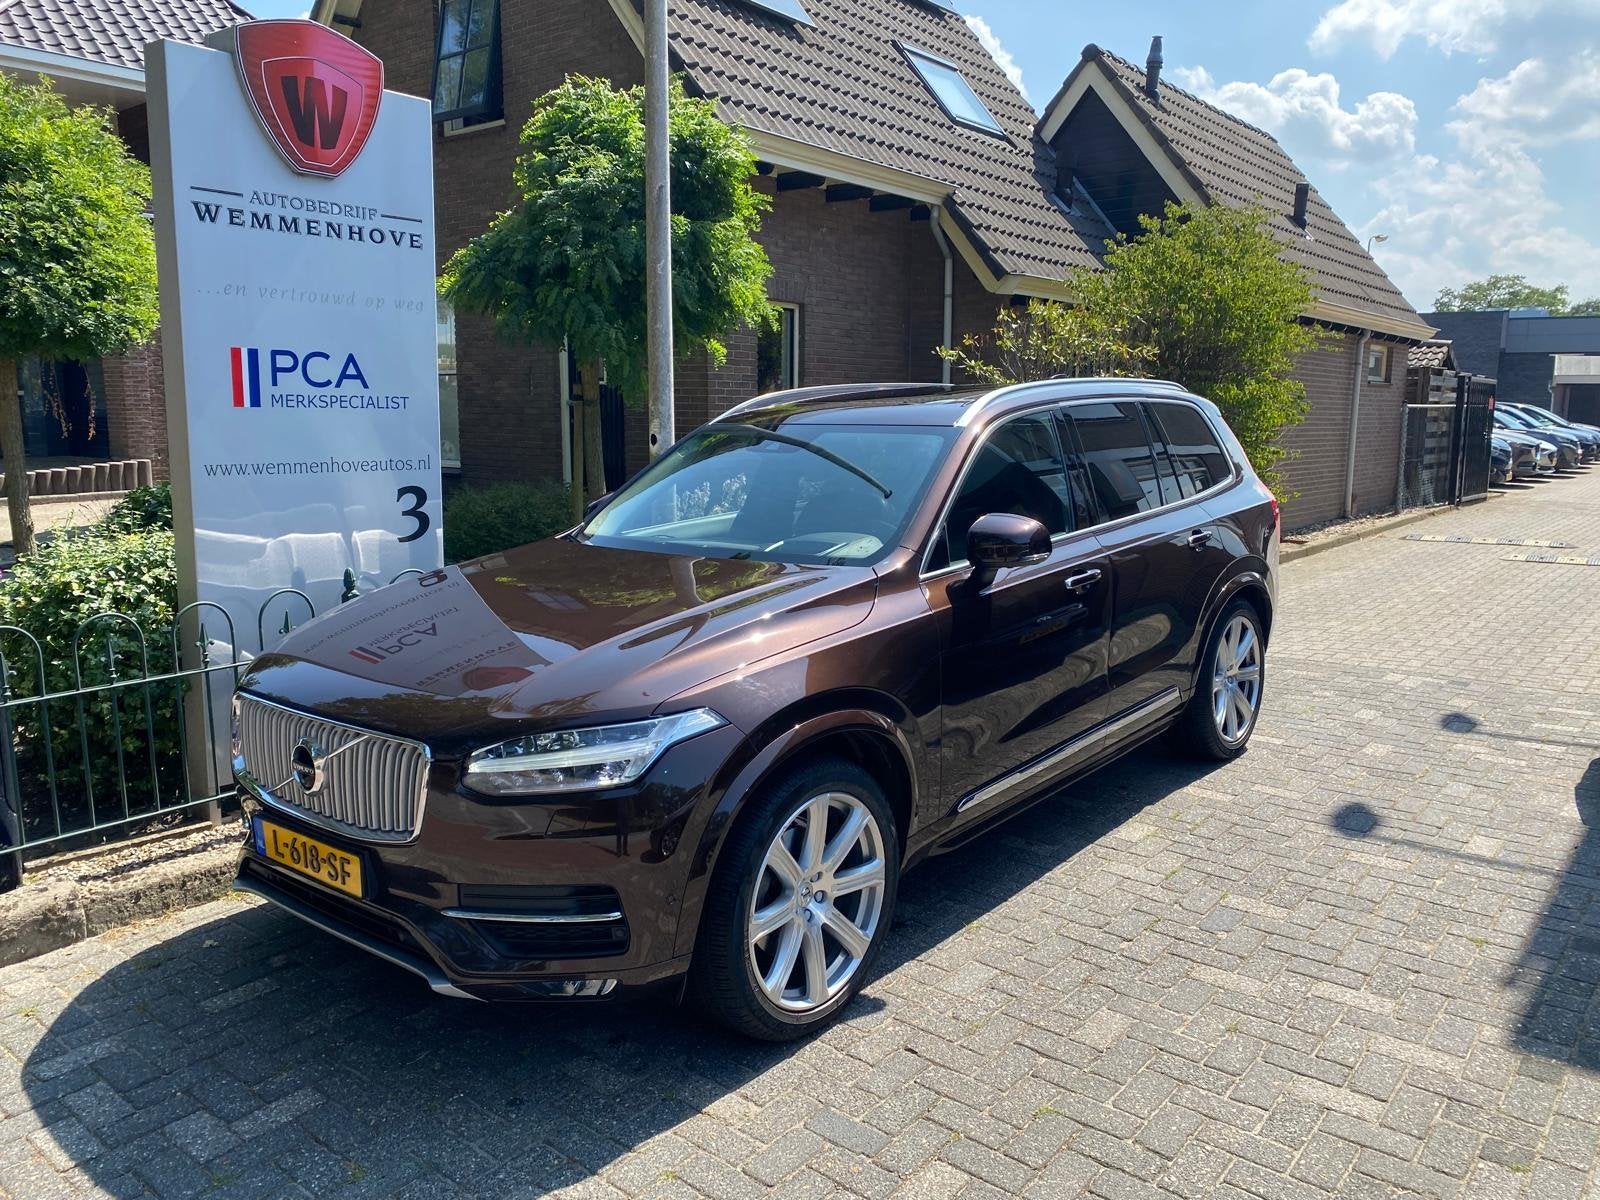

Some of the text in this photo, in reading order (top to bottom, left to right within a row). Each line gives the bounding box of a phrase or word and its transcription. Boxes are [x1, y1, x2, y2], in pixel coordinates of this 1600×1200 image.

[281, 75, 348, 150] W
[191, 200, 424, 250] WEMMENHOVE
[365, 295, 385, 310] op
[270, 349, 370, 390] PCA
[270, 393, 410, 410] MERKSPECIALIST
[204, 454, 432, 477] www.wemmenhoveautos.nl
[396, 485, 431, 543] 3
[272, 829, 351, 885] L-618-SF
